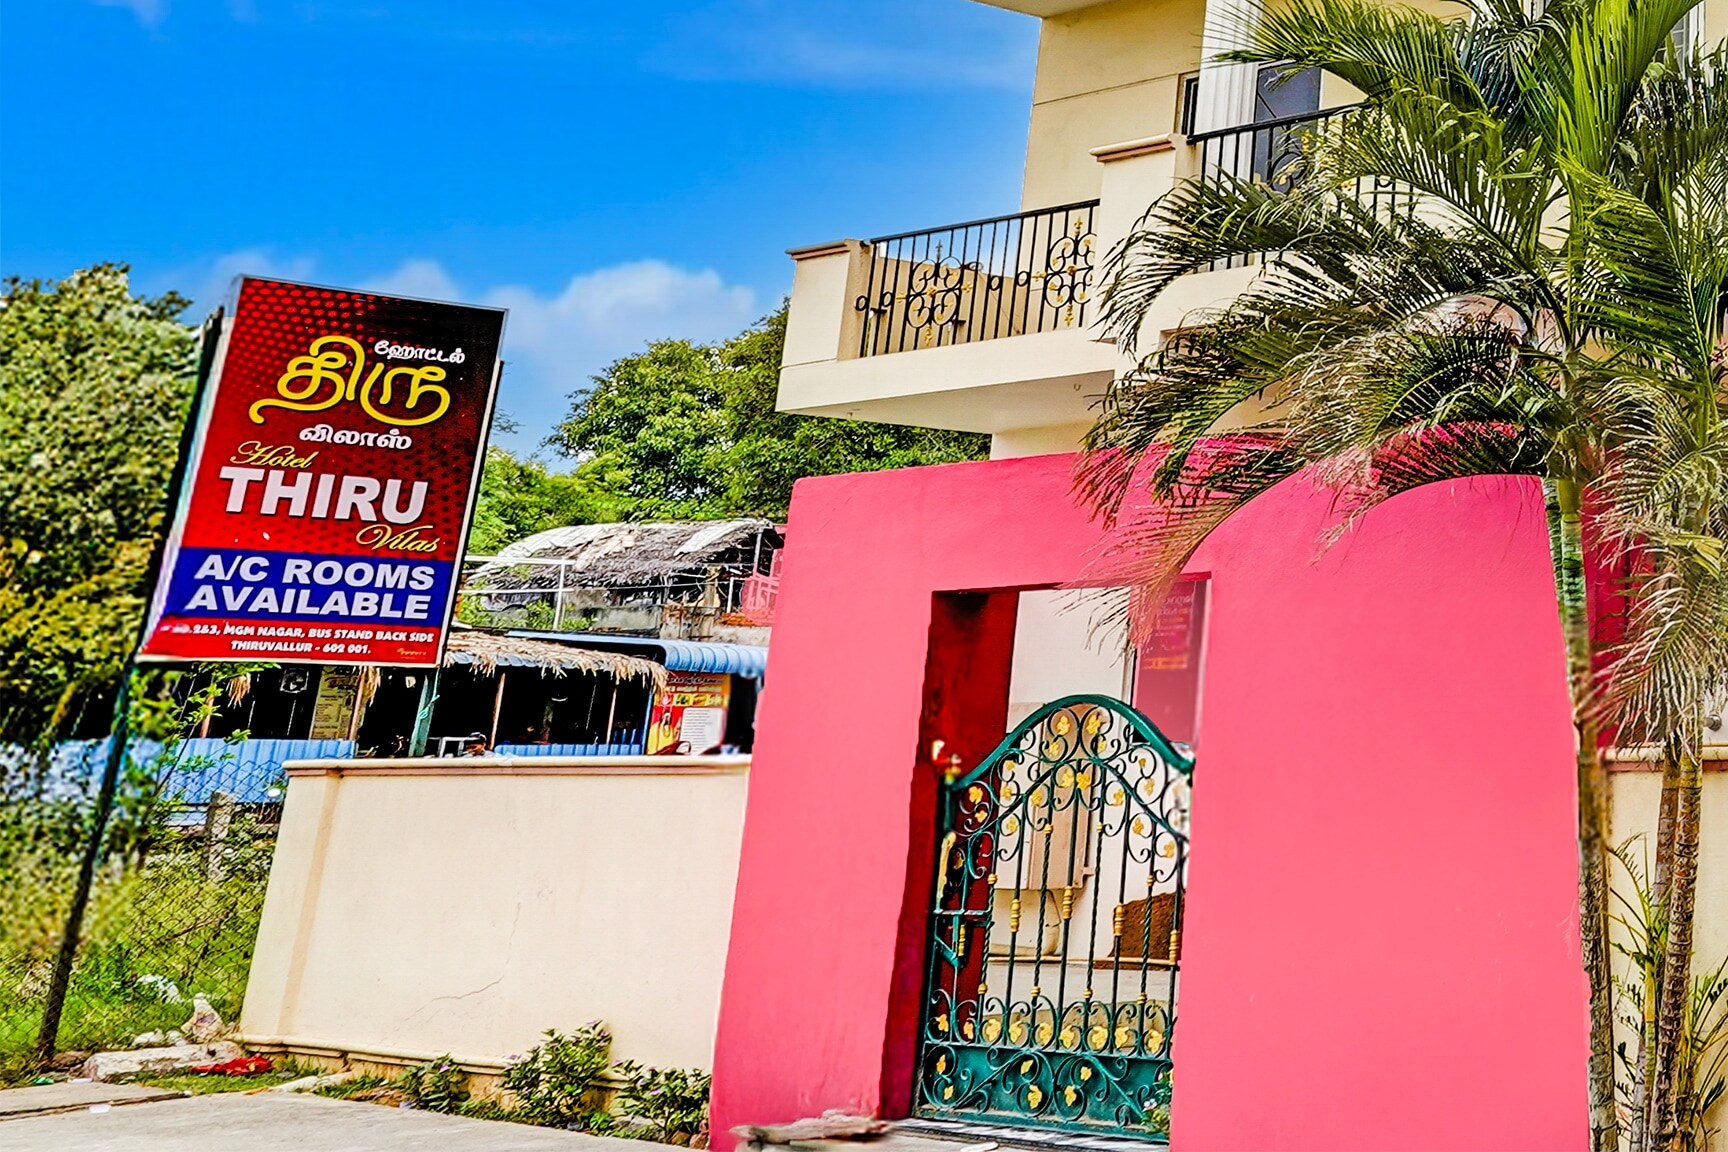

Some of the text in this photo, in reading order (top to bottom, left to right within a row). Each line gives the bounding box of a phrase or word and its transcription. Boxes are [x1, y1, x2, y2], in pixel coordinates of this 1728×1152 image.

[374, 340, 466, 364] ஹோட்டல்
[249, 335, 451, 426] திரு
[299, 424, 412, 449] விலாஸ்
[230, 441, 318, 469] Hotel
[219, 465, 429, 524] THIRU
[355, 524, 440, 553] Vilas
[195, 554, 435, 590] A/C ROOMS
[188, 585, 431, 620] AVAILABLE
[223, 625, 255, 636] MGM
[257, 627, 306, 638] NAGAR,
[308, 628, 332, 639] BUS
[333, 629, 374, 640] STAND
[375, 631, 408, 641] BACK
[408, 632, 434, 642] SIDE
[230, 640, 313, 653] THIRUVALLUR
[322, 643, 346, 654] 602
[347, 644, 372, 655] 001.
